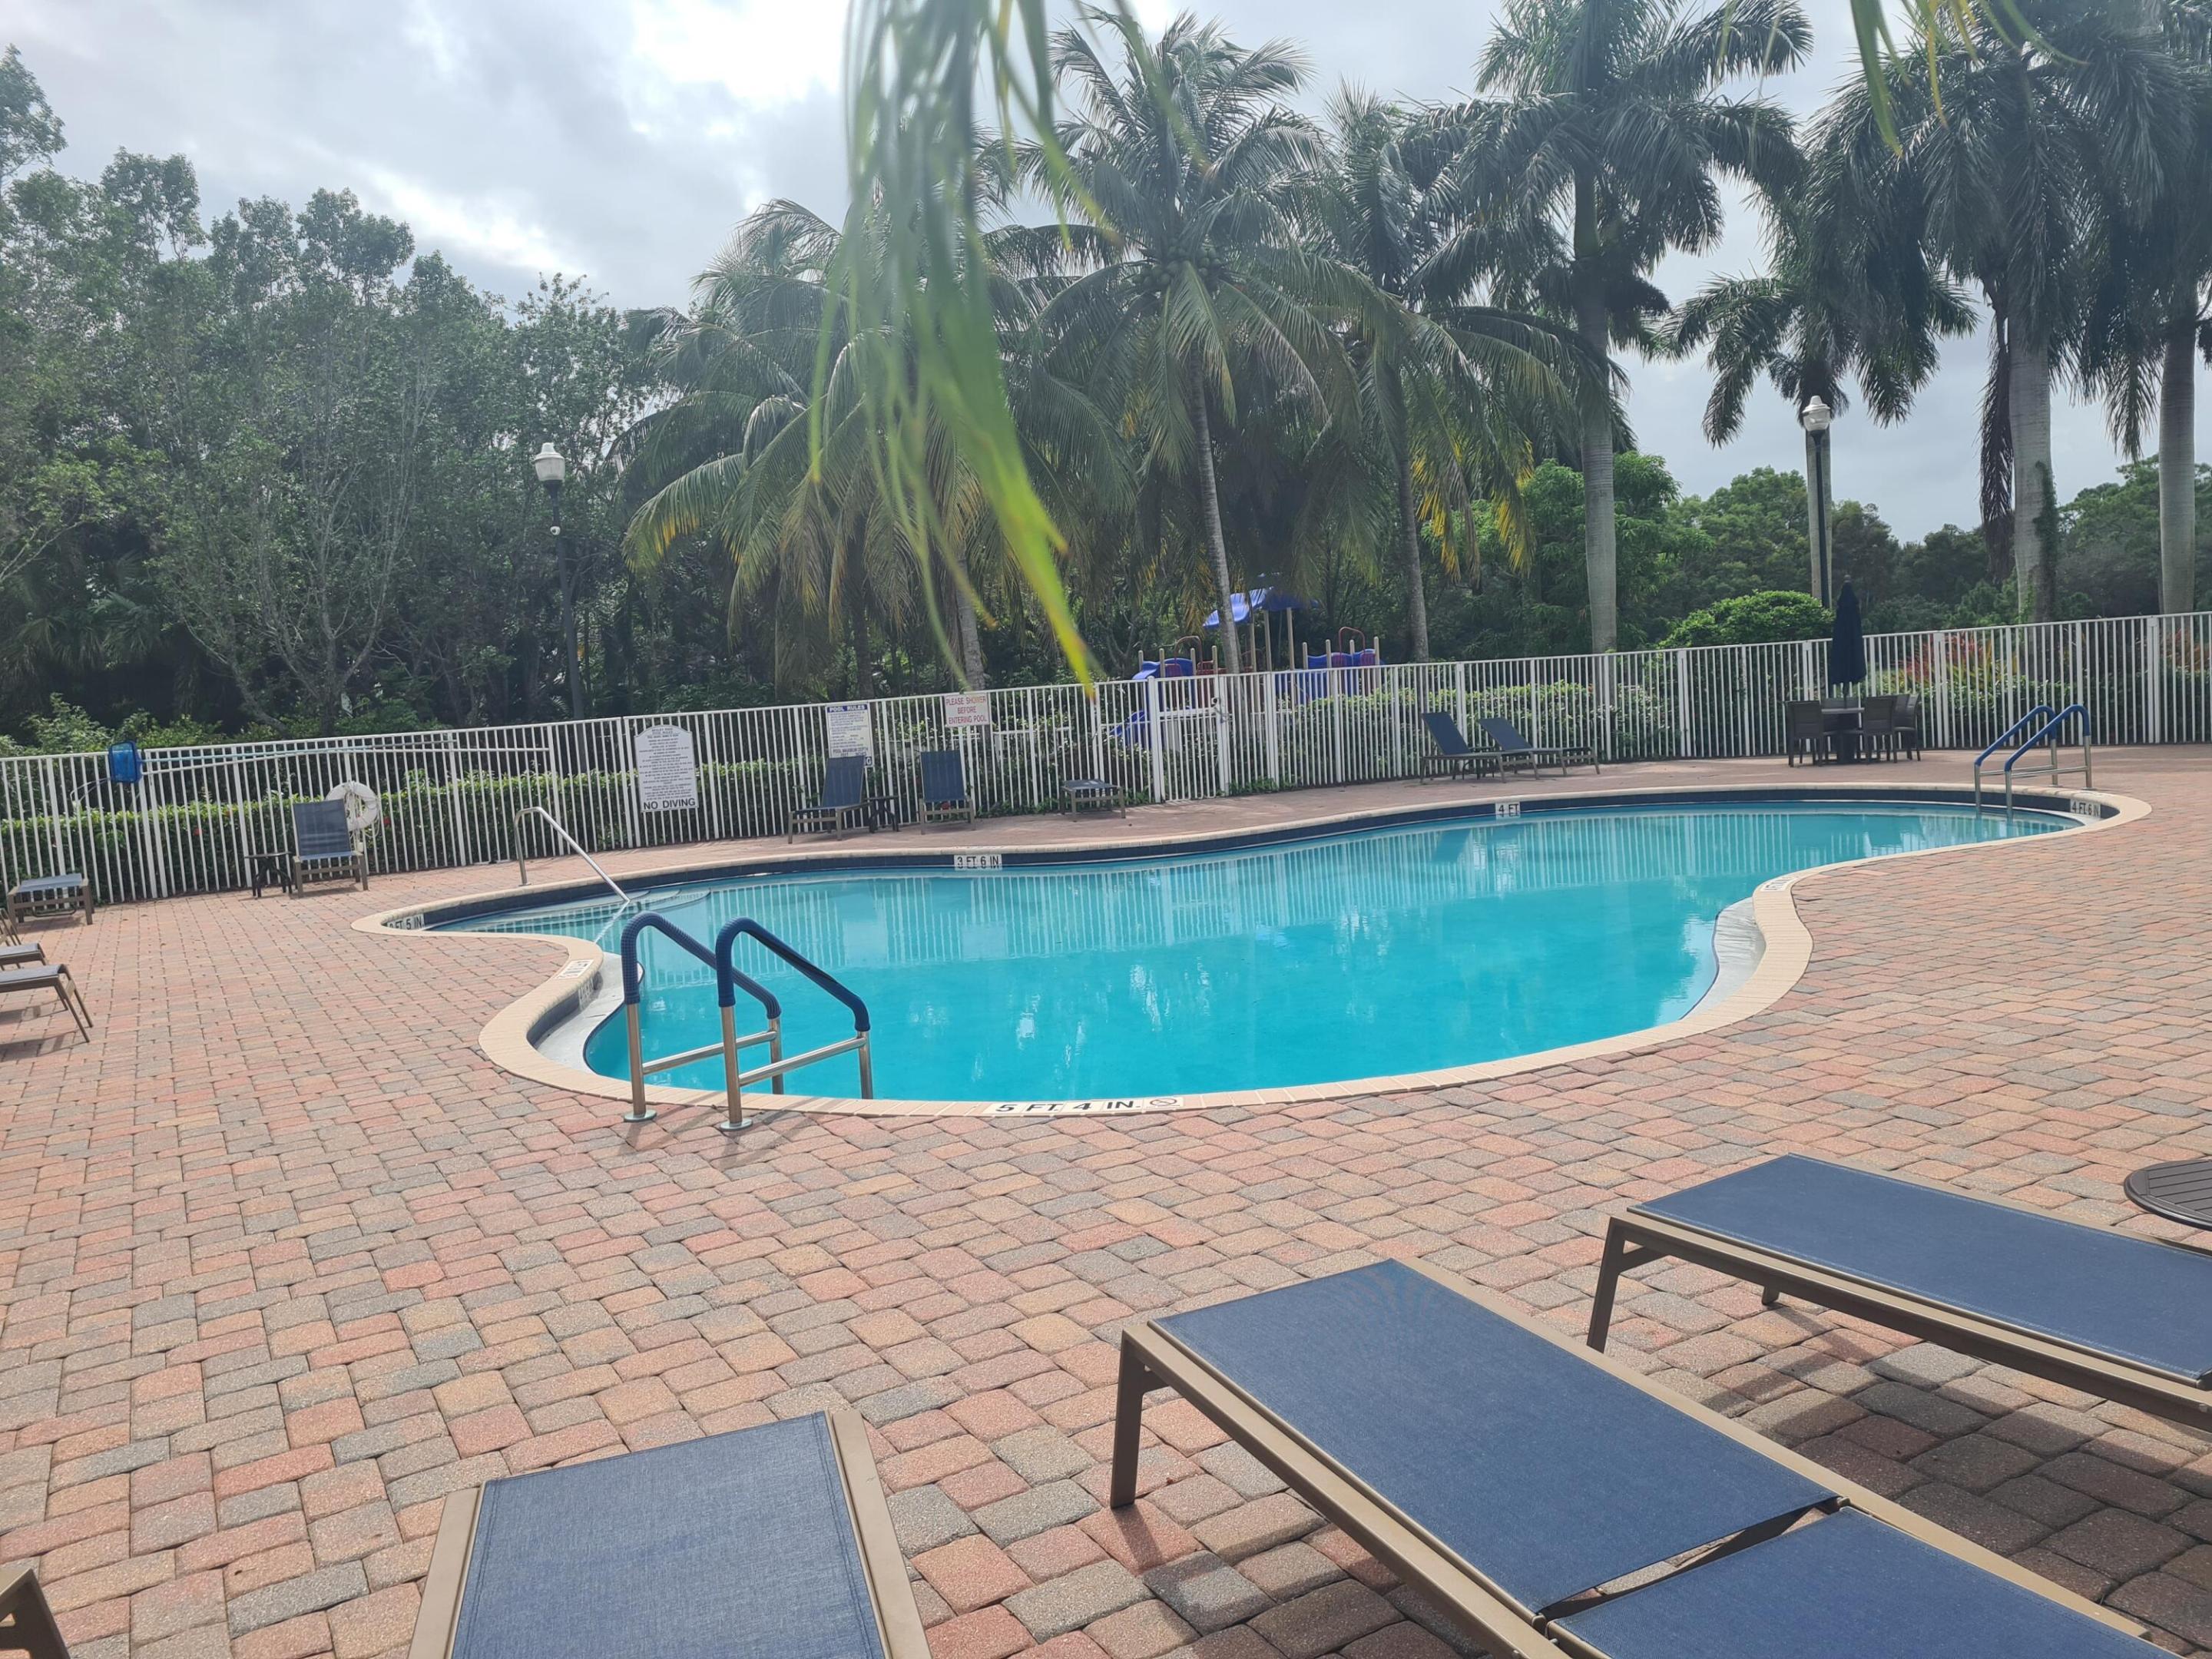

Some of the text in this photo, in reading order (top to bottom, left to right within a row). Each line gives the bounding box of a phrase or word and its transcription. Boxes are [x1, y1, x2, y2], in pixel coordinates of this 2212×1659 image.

[945, 695, 986, 705] PLEASE SHOWER
[957, 706, 977, 714] BEFORE
[949, 715, 972, 724] ENTERING
[644, 797, 696, 810] NO DIVING
[1498, 803, 1519, 814] 4 FT
[2072, 801, 2077, 814] 4
[957, 856, 963, 867] 3
[966, 856, 976, 867] FT
[980, 856, 986, 867] 6
[406, 918, 412, 930] 5
[995, 1104, 1018, 1112] 5
[1025, 1103, 1063, 1112] FT.
[1072, 1101, 1092, 1111] 4
